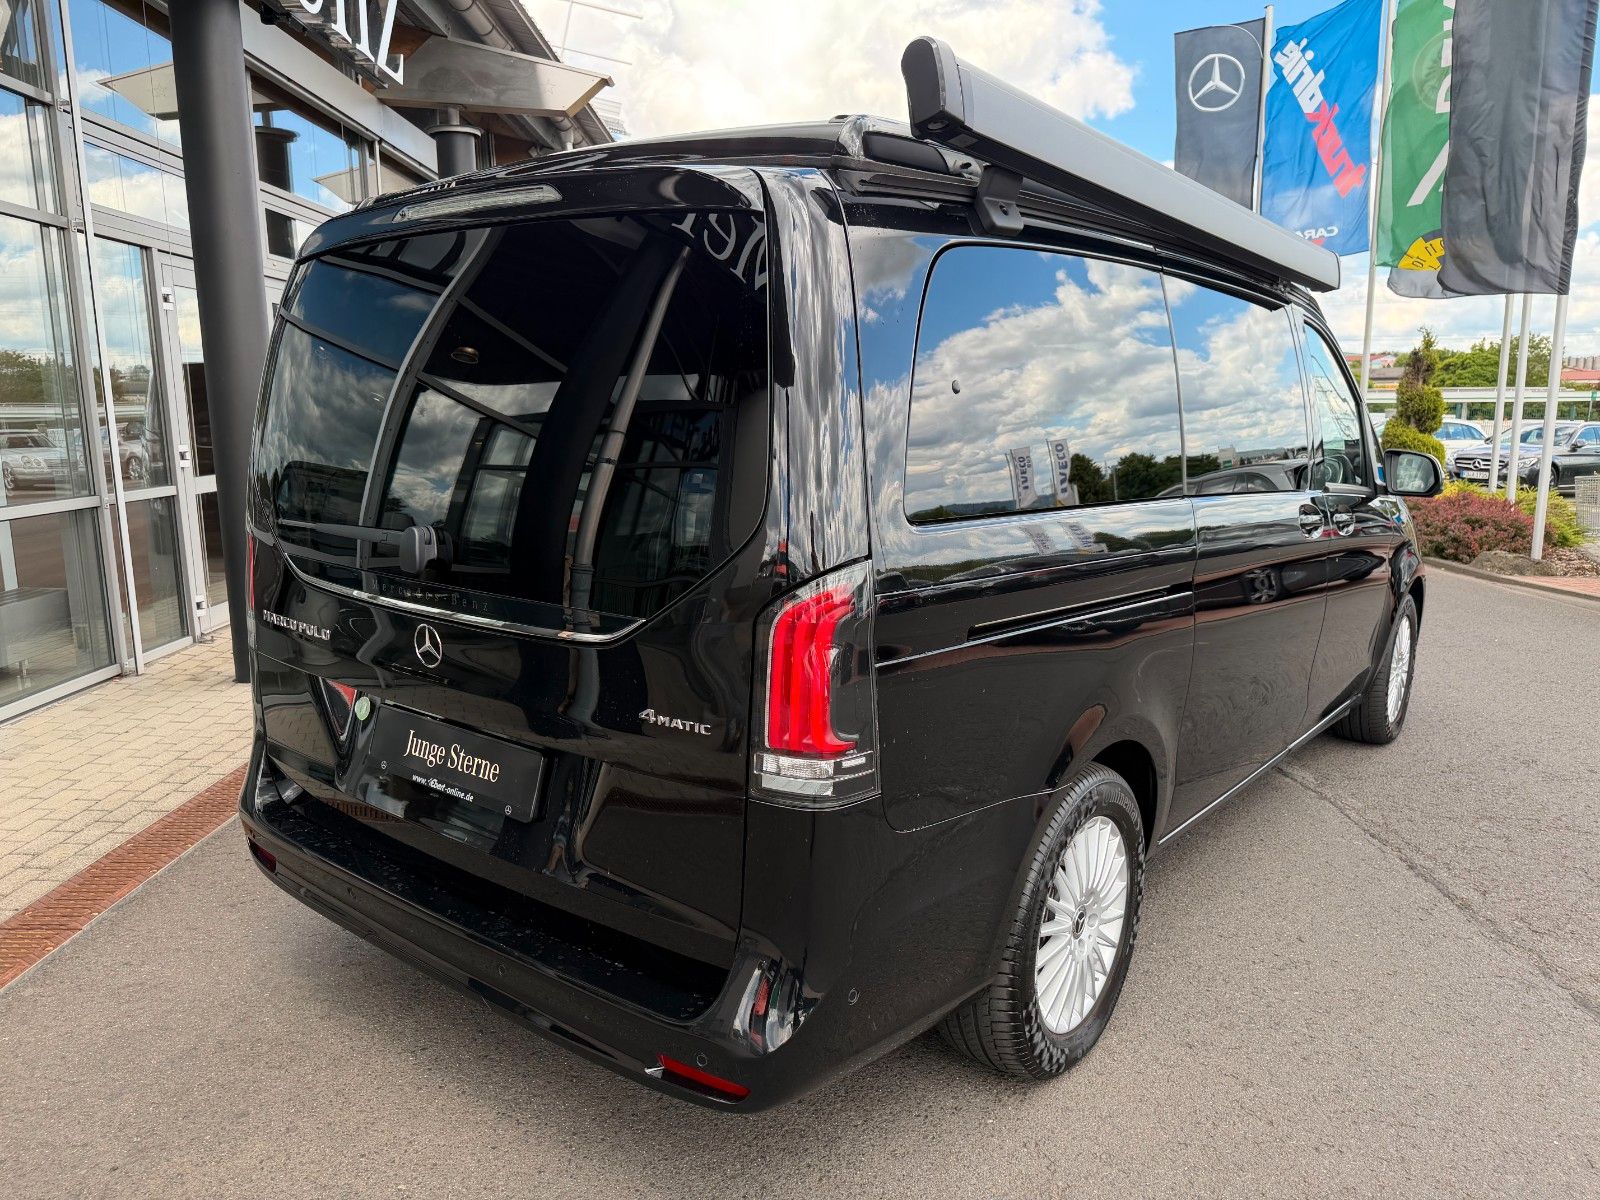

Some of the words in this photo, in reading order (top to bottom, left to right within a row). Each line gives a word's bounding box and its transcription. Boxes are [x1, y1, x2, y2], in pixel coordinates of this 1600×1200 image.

[1017, 456, 1030, 490] IVECO
[1054, 443, 1069, 494] IVECO
[262, 609, 297, 631] MARCO
[298, 621, 332, 641] POLO
[638, 708, 712, 736] 4MATIC
[403, 729, 446, 768] Junge
[447, 743, 500, 782] Sterne
